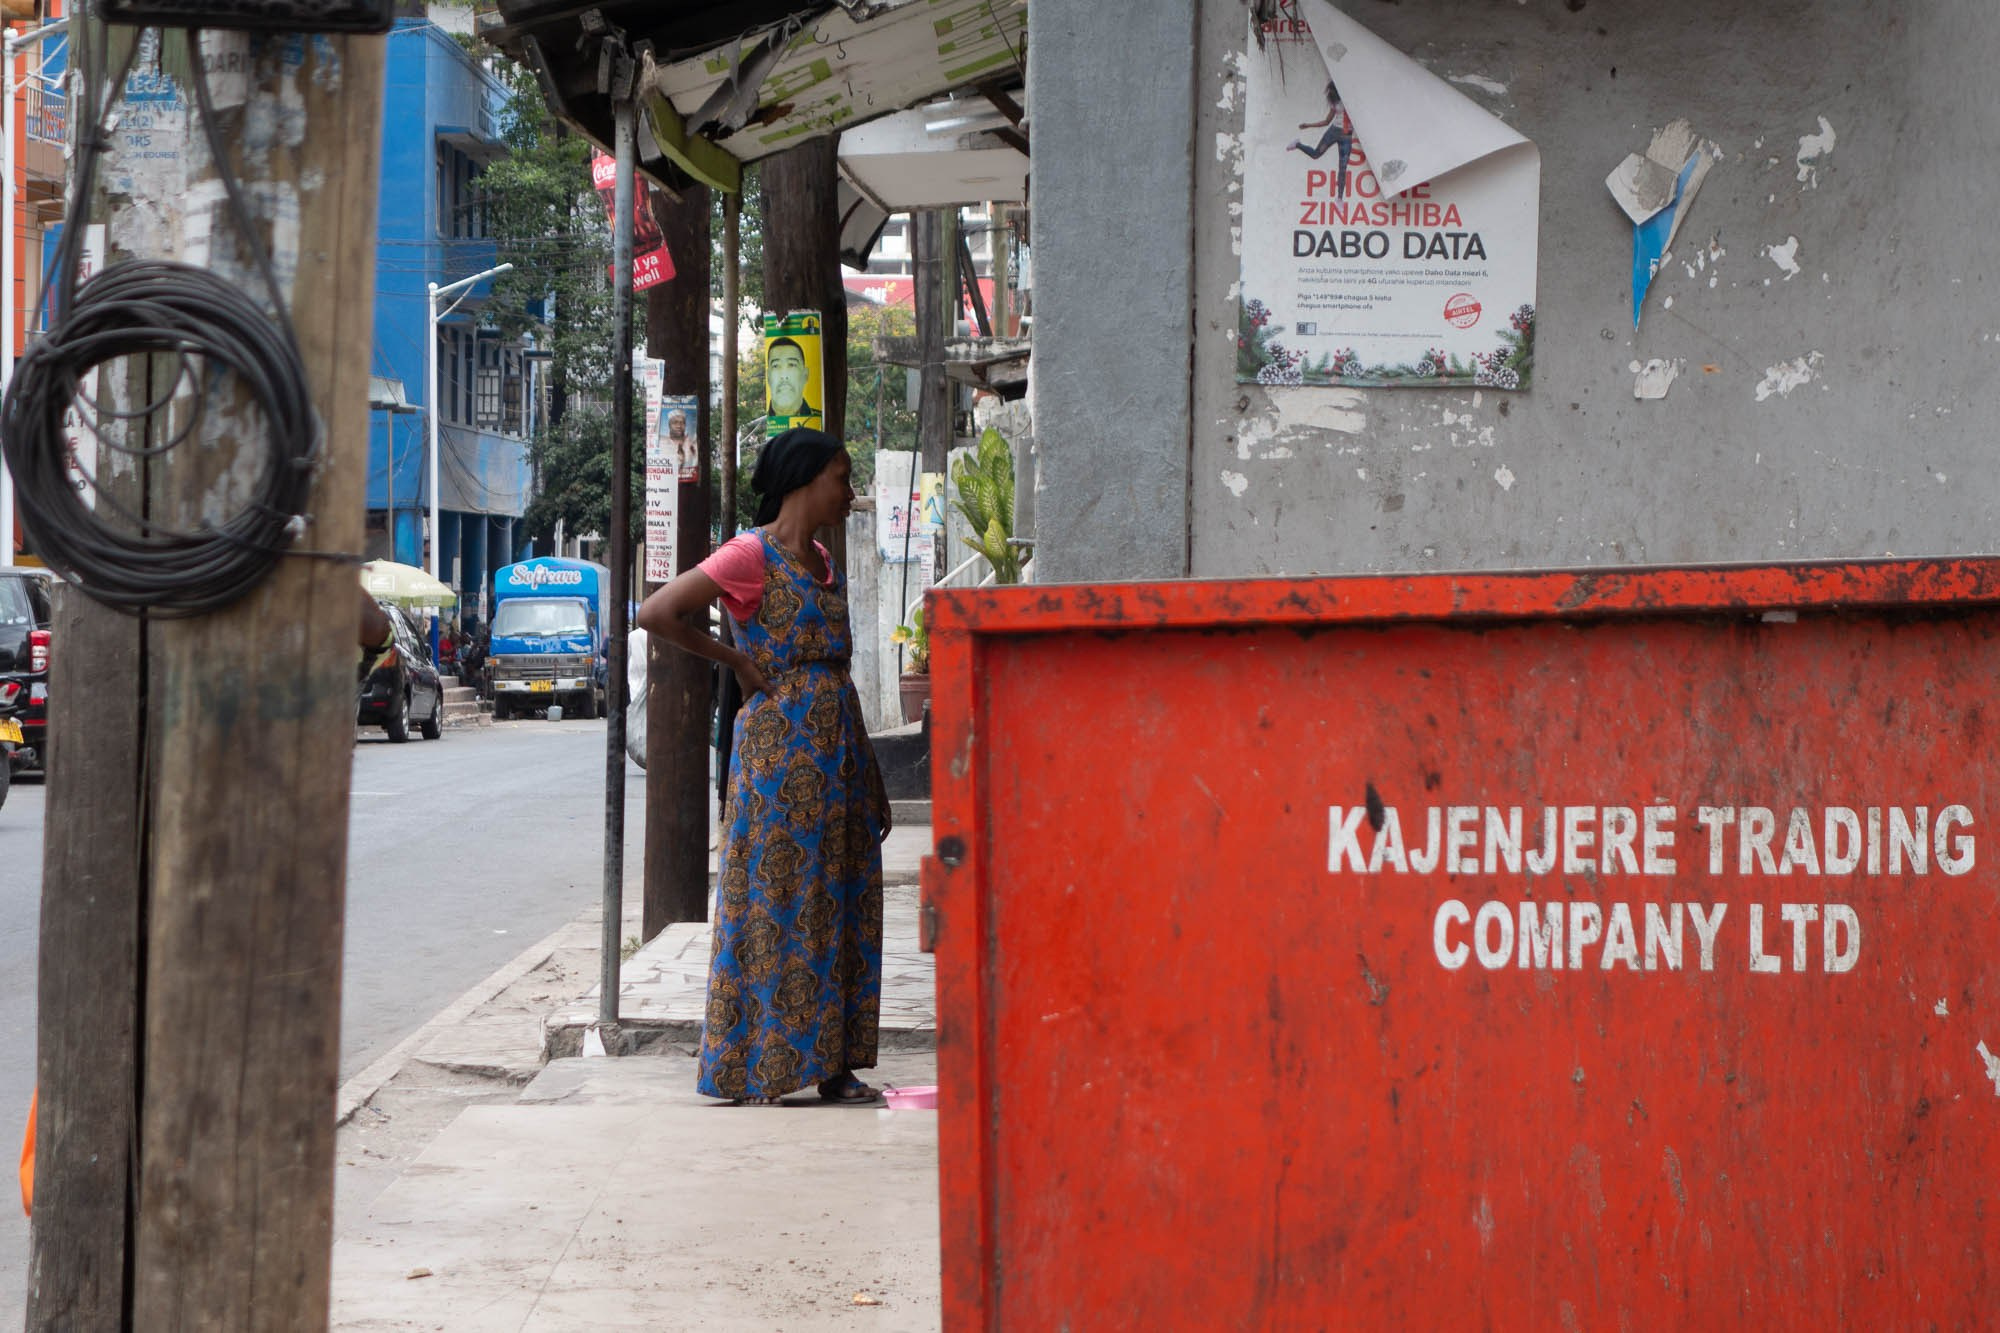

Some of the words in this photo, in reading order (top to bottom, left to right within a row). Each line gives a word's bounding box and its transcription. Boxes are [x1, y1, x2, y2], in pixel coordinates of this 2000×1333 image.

[1306, 169, 1432, 199] PHOE
[1299, 201, 1463, 228] ZINASHIBA
[1292, 230, 1390, 260] DABO
[1403, 231, 1488, 262] DATA
[632, 267, 661, 289] well
[509, 564, 582, 590] Softcare
[522, 656, 560, 664] TOYOTA
[1327, 805, 1678, 875] KAJENJERE
[1697, 804, 1976, 876] TRADING
[1432, 899, 1728, 970] COMPANY
[1748, 902, 1861, 973] LTD
